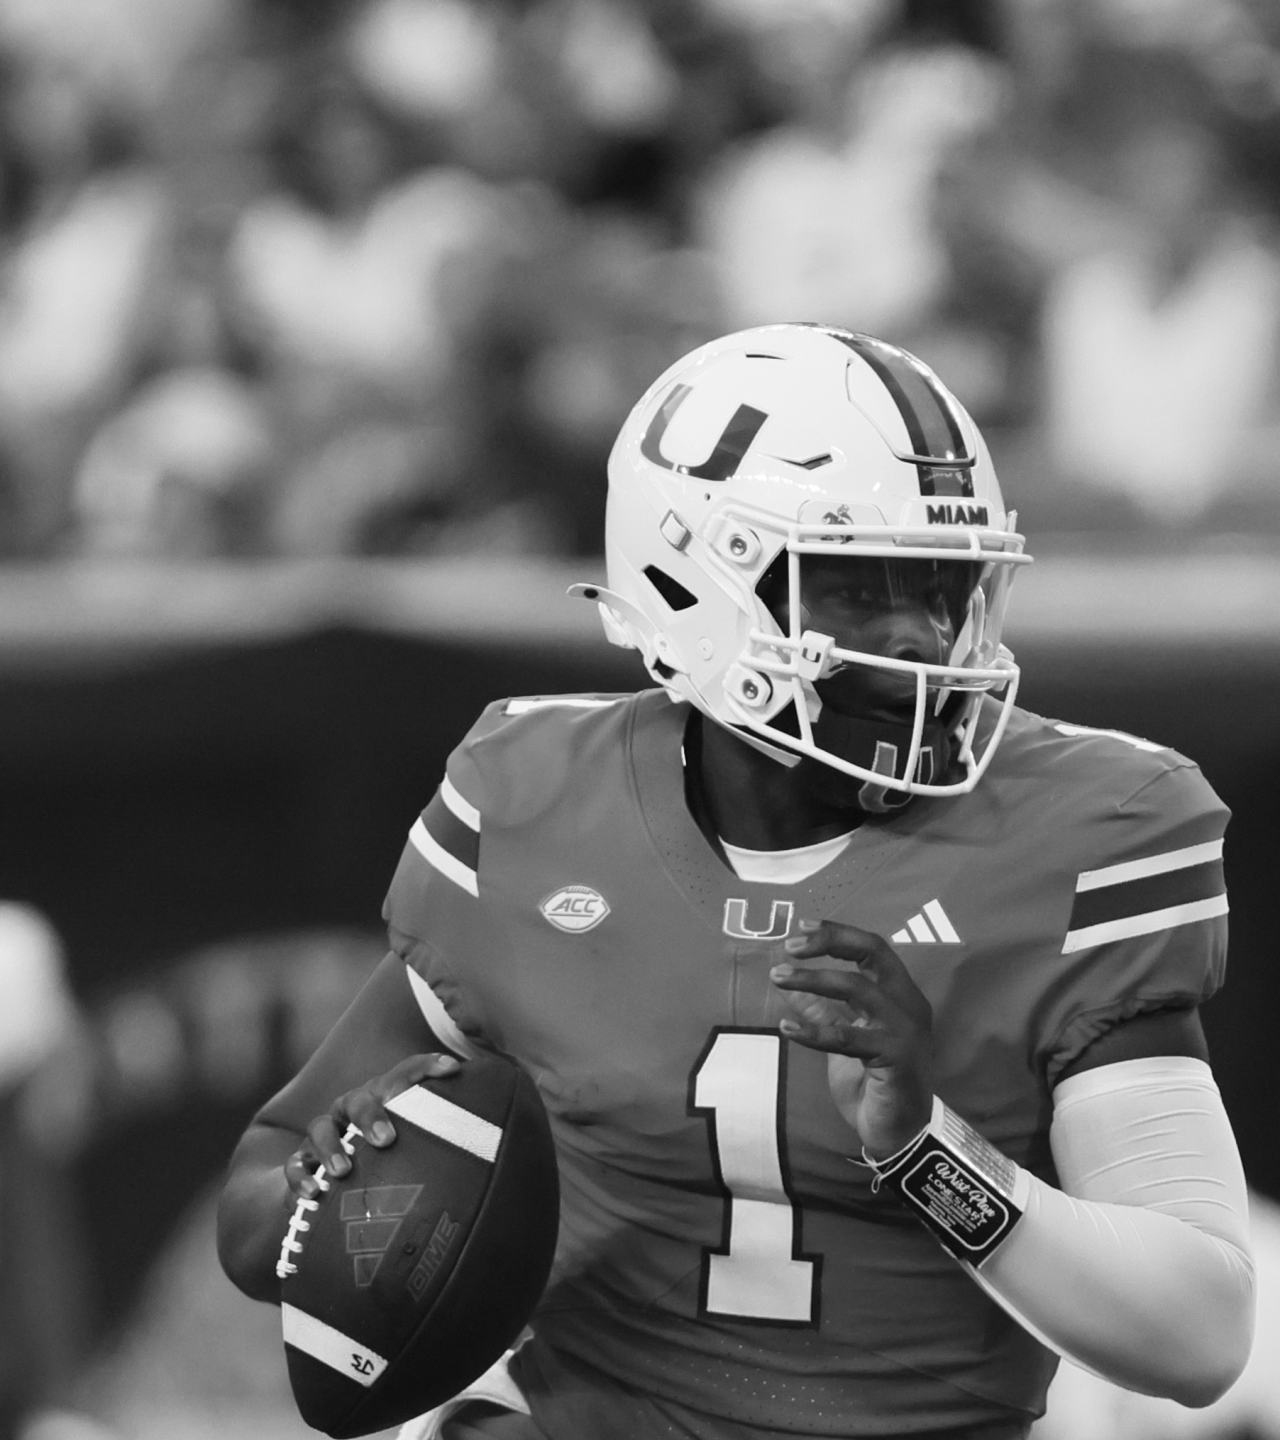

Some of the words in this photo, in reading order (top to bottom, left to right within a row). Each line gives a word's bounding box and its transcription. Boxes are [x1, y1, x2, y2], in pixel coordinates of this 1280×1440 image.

[640, 382, 769, 482] U
[926, 504, 989, 526] MIAMI
[551, 898, 600, 913] ACC
[723, 897, 794, 941] U
[688, 1026, 823, 1324] 1
[935, 1161, 971, 1193] Wrist
[968, 1189, 996, 1217] Plan
